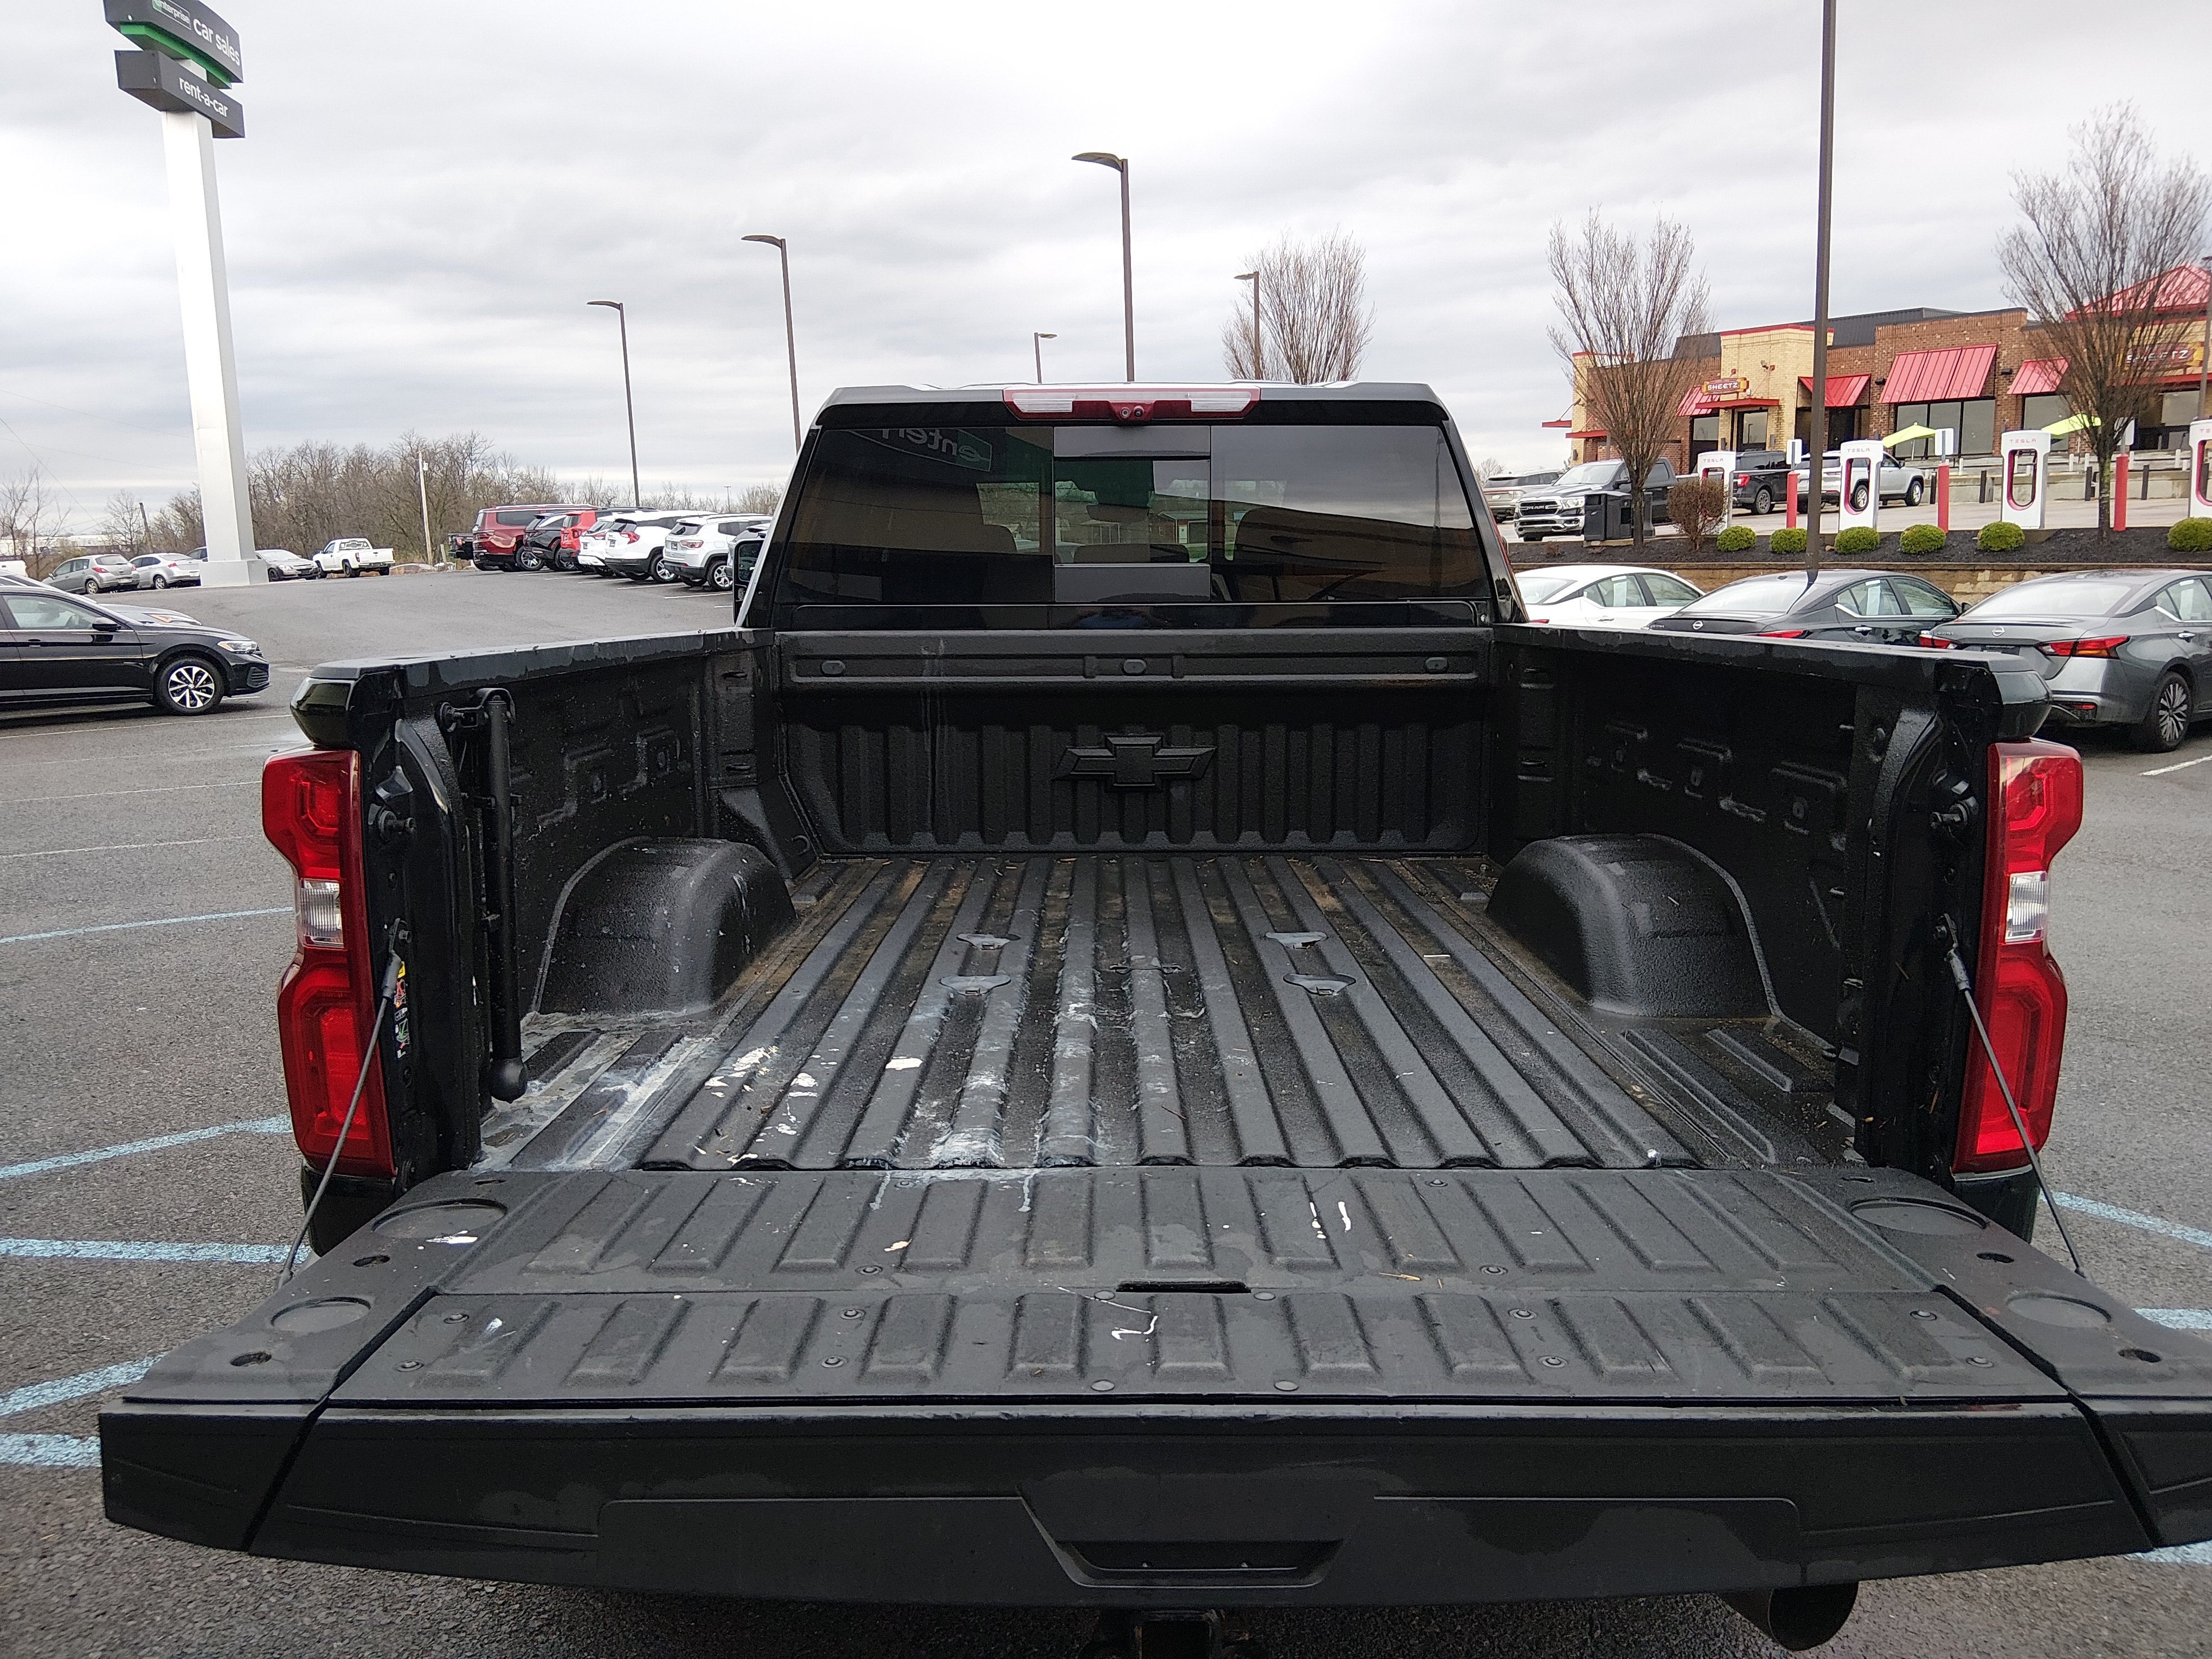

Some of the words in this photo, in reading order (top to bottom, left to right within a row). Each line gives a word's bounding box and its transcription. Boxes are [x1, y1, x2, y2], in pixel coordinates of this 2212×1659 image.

[193, 18, 214, 43] car
[215, 35, 240, 66] sales
[178, 77, 228, 118] rent-a-car
[1707, 382, 1738, 391] SHEETZ
